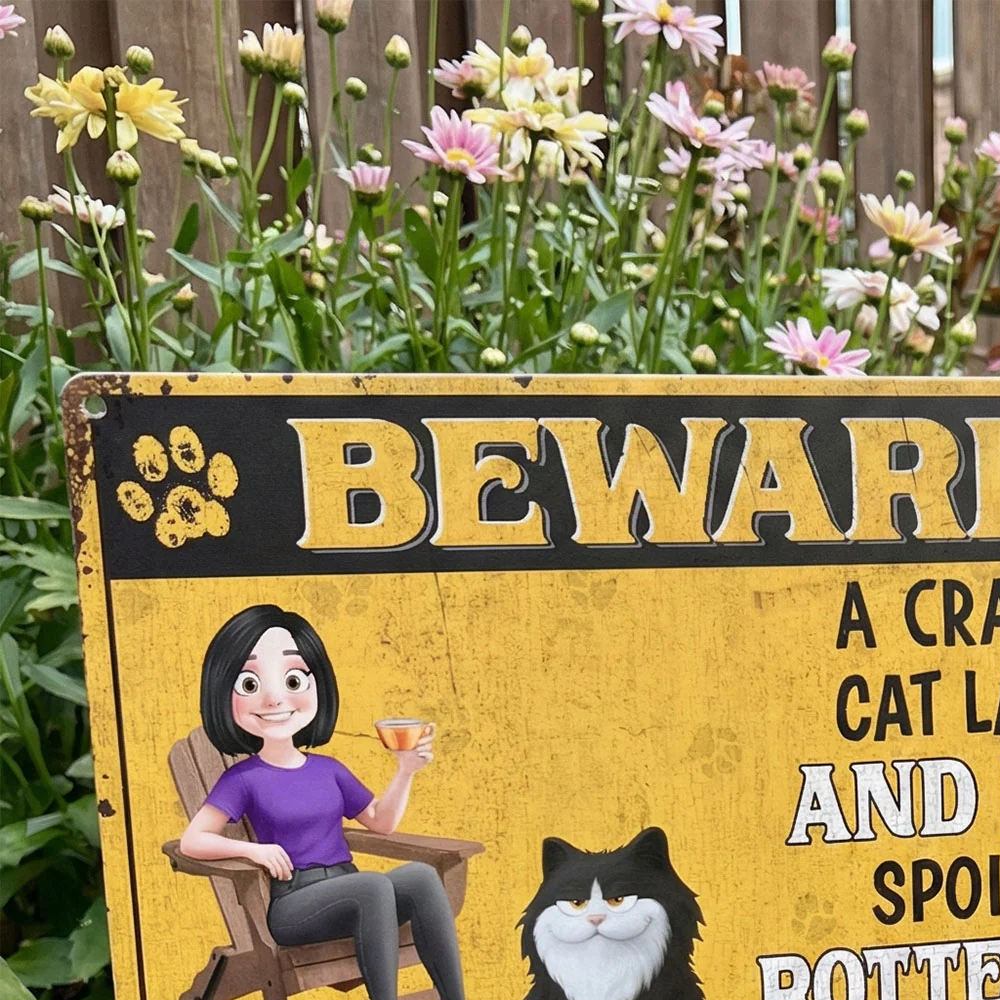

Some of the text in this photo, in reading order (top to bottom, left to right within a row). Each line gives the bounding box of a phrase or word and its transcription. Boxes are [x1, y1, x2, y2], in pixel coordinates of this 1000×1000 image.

[836, 580, 877, 650] A
[836, 671, 942, 741] CAT
[785, 757, 979, 846] AND
